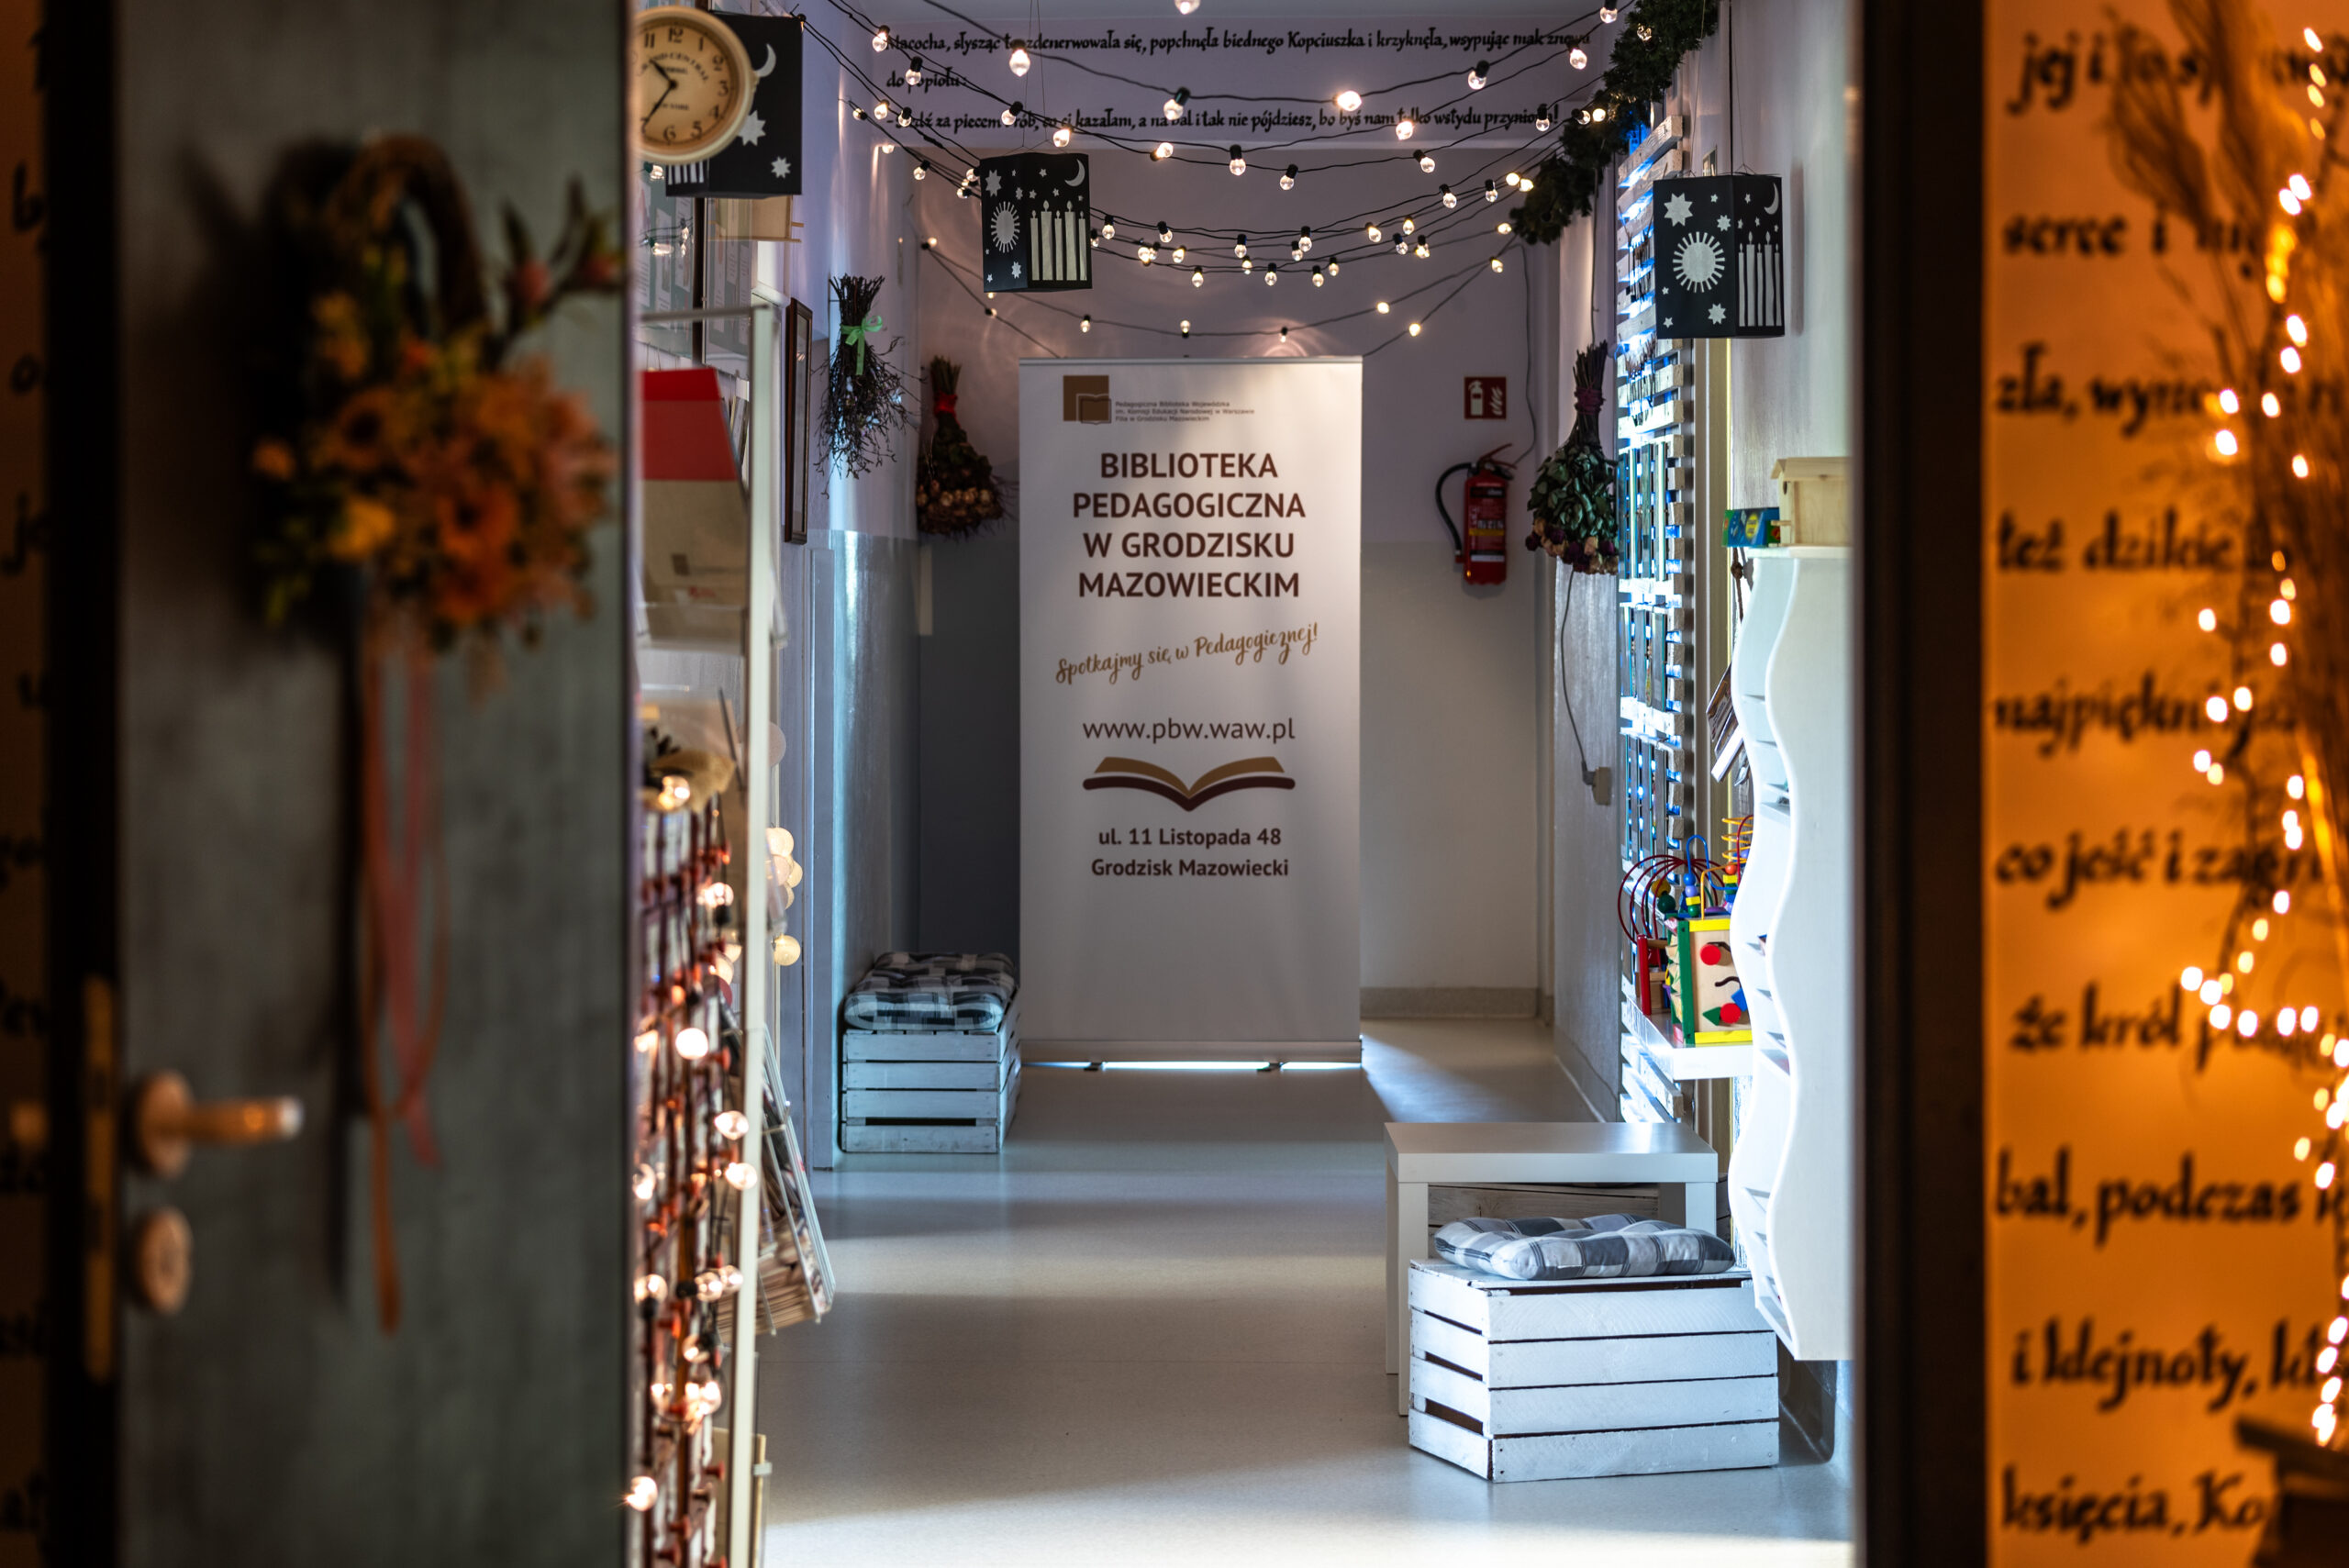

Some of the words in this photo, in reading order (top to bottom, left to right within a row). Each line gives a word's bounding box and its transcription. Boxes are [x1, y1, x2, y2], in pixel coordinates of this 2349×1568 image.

[954, 31, 1000, 55] słysząc
[1027, 29, 1120, 50] zdenerwowała
[1124, 34, 1147, 55] się,
[1150, 27, 1219, 56] popchnęła
[1223, 29, 1284, 55] biednego
[1287, 28, 1365, 53] Kopciuszka
[1367, 33, 1373, 48] i
[1376, 27, 1447, 51] krzyknęła,
[1449, 30, 1509, 51] wsypując
[1513, 28, 1545, 45] mak
[886, 70, 905, 87] do
[936, 116, 951, 128] za
[953, 113, 1000, 134] piecem
[1075, 108, 1136, 129] kazałam,
[1139, 117, 1147, 127] a
[1151, 117, 1168, 127] na
[1196, 114, 1200, 127] i
[1202, 109, 1225, 128] tak
[1229, 111, 1248, 127] nie
[1250, 108, 1317, 132] pójdziesz,
[1319, 108, 1335, 127] bo
[1340, 109, 1362, 130] byś
[1364, 115, 1395, 126] nam
[1397, 107, 1431, 124] tlko
[1433, 107, 1483, 129] wstydu
[1484, 104, 1559, 130] przynioa!
[1101, 452, 1278, 478] BIBLIOTEKA
[1073, 493, 1306, 517] PEDAGOGICZNA
[1083, 533, 1112, 558] W
[1121, 532, 1294, 558] GRODZISKU
[1079, 573, 1299, 597] MAZOWIECKIM
[1056, 651, 1144, 684] Spotkajmy
[1148, 645, 1172, 664] się
[1175, 646, 1189, 660] w
[1194, 622, 1319, 666] Pedagogicznej!
[1083, 717, 1296, 744] www.pbw.waw.pl
[1098, 828, 1121, 845] ul.
[1129, 828, 1152, 845] 11
[1159, 828, 1251, 849] Listopada
[1257, 828, 1281, 845] 48
[1091, 859, 1173, 876] Grodzisk
[1179, 859, 1289, 876] Mazowiecki
[1997, 1145, 2087, 1231] bal,
[2094, 1151, 2301, 1251] podczas
[2011, 1330, 2032, 1386] i
[2044, 1317, 2257, 1414] klejnoty,
[2002, 1462, 2186, 1546] księcia,
